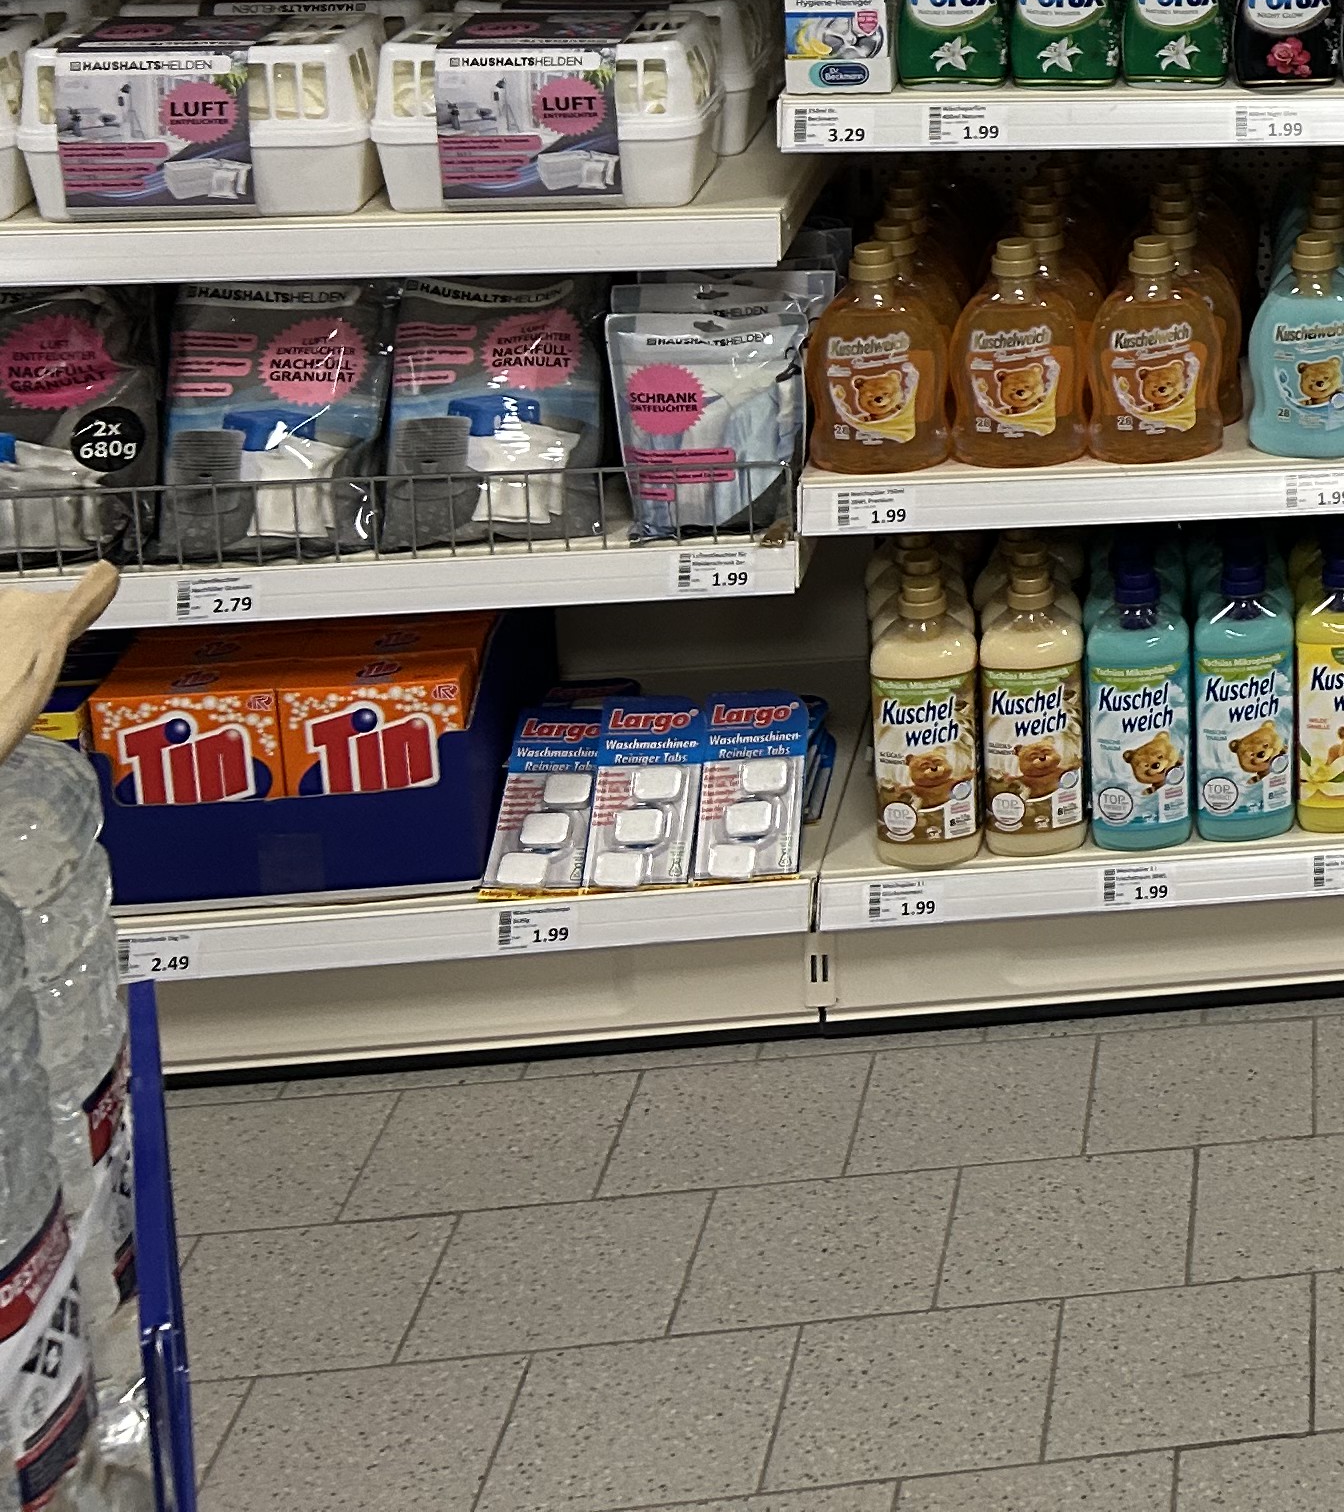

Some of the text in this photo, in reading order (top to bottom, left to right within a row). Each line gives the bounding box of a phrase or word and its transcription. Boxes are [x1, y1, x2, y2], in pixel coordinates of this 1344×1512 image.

[461, 56, 582, 68] HAUSHALTSHELDEN
[170, 99, 226, 118] LUFT
[542, 96, 597, 113] LUFT
[828, 128, 865, 143] 3.29
[1268, 123, 1302, 137] 1.99
[629, 390, 698, 405] SCHRANK
[93, 420, 123, 437] 2x
[79, 438, 137, 461] 680g
[213, 597, 252, 613] 2.79
[1100, 684, 1169, 710] Kuschel
[712, 702, 790, 726] Largo
[882, 697, 955, 724] Kuschel
[608, 710, 690, 733] Largo
[1122, 709, 1174, 733] weich
[905, 724, 959, 746] weich
[306, 707, 436, 792] Tin
[606, 738, 699, 751] Waschmaschinen-
[719, 744, 790, 759] Reiniger Tabs
[125, 719, 253, 803] Tin
[1135, 885, 1168, 900] 1.99
[533, 927, 569, 943] 1.99
[151, 957, 189, 972] 2.49
